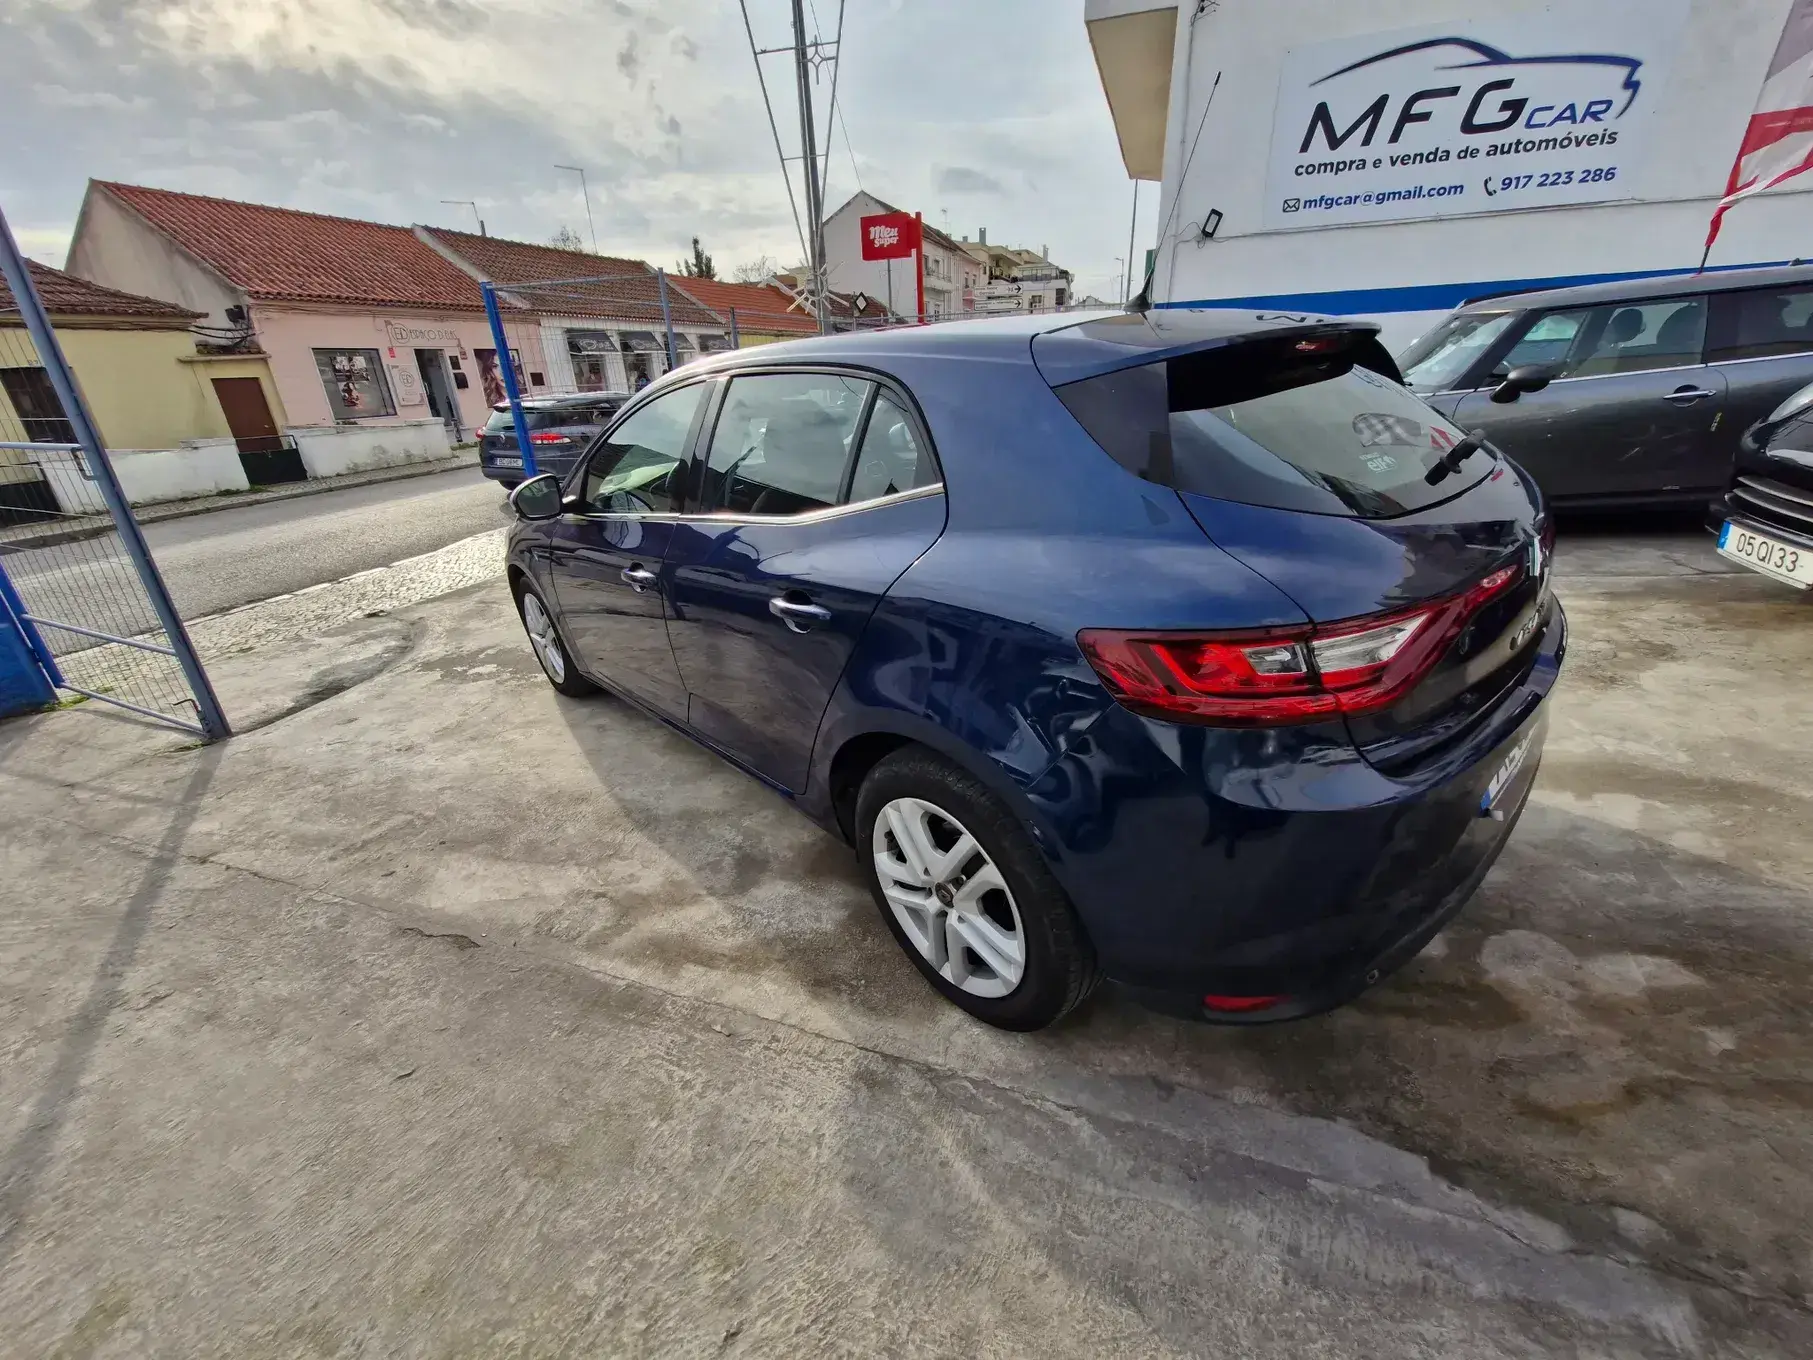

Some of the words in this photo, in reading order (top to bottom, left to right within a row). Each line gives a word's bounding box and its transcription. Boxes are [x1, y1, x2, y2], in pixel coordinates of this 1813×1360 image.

[1299, 78, 1529, 153] MFG
[1524, 99, 1613, 129] CAR
[1294, 157, 1367, 177] compra
[1372, 157, 1382, 169] e
[1389, 147, 1451, 167] venda
[1456, 146, 1480, 160] de
[1485, 128, 1619, 157] automóveis
[1500, 174, 1534, 191] 917
[1536, 170, 1575, 188] 223
[1578, 166, 1618, 183] 286
[1302, 184, 1465, 210] mfgcar@gmail.com
[869, 225, 899, 239] Meu
